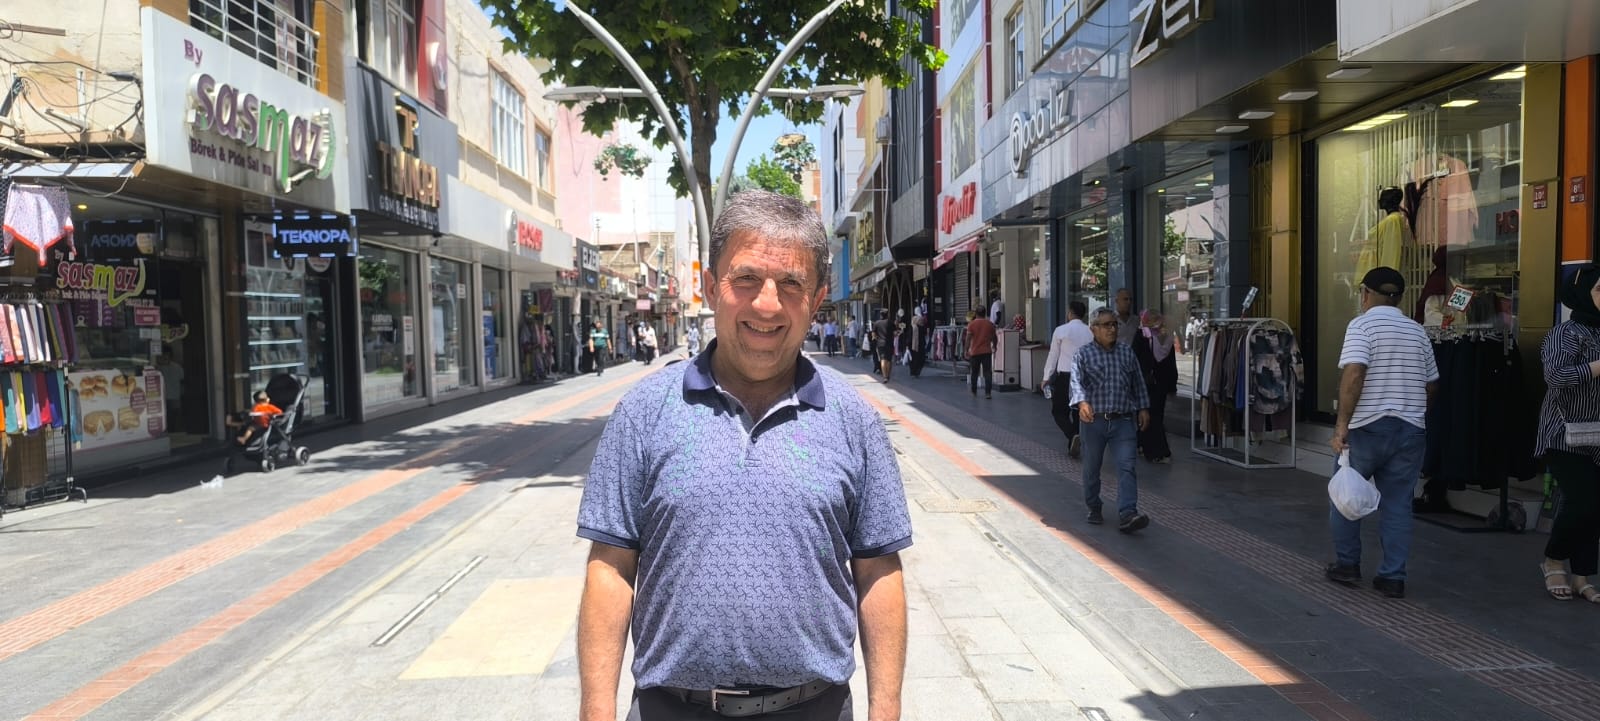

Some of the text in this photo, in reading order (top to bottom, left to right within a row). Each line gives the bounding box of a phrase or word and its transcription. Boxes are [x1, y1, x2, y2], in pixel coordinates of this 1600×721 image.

[1129, 0, 1200, 68] ZE
[183, 39, 203, 67] By
[190, 138, 218, 160] Börek
[219, 146, 226, 163] &
[279, 229, 351, 244] TEKNOPA
[1450, 294, 1466, 306] 250
